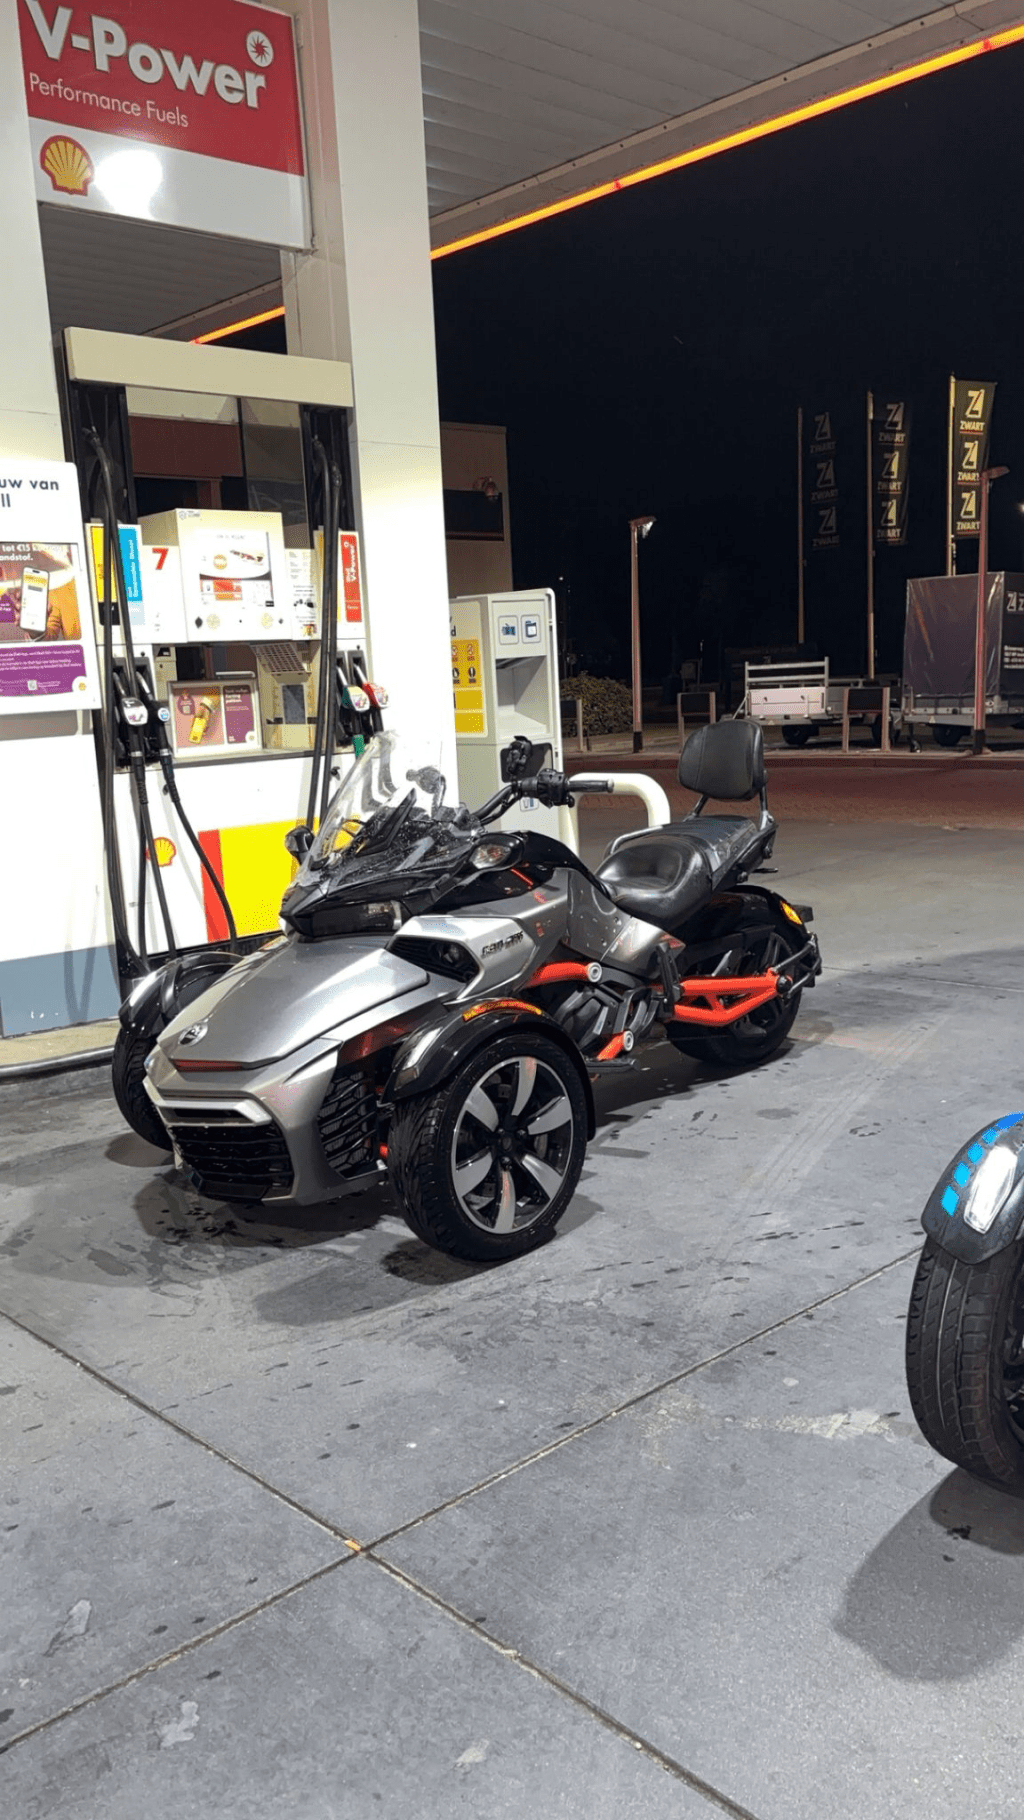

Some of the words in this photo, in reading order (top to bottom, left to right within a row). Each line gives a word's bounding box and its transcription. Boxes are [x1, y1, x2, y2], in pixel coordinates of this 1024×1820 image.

[25, 0, 266, 109] V-Power
[29, 72, 141, 117] Performance
[146, 101, 189, 128] Fuels
[960, 421, 985, 431] ZWART
[29, 480, 59, 490] van
[956, 521, 980, 531] ZWART
[152, 548, 169, 570] 7
